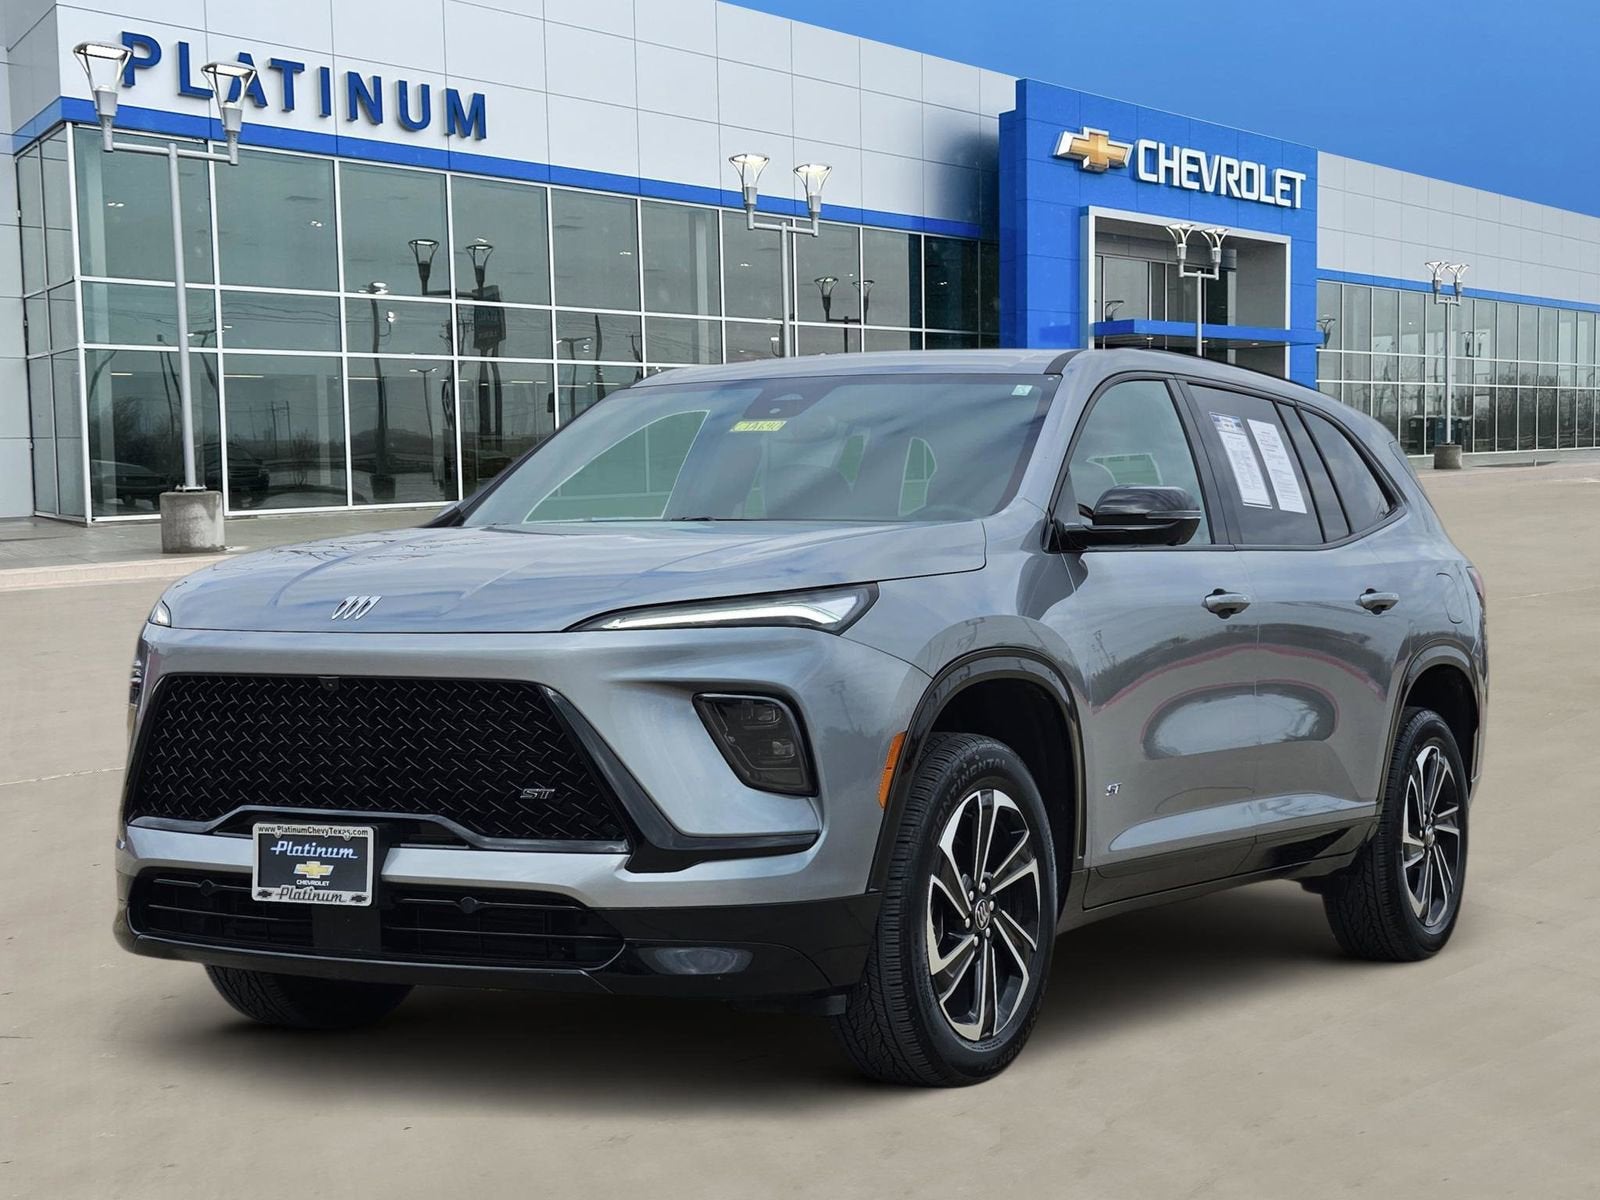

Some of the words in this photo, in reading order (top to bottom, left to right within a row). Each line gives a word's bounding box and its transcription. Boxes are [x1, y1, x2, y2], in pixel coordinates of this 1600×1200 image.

[121, 31, 487, 140] PLATINUM
[1136, 139, 1306, 209] CHEVROLET
[520, 788, 555, 799] ST
[257, 825, 368, 836] wwwPlatinumChevyTexas.com
[270, 841, 358, 859] Platinum
[296, 879, 330, 887] CHEVROLET
[275, 886, 347, 903] Platinum
